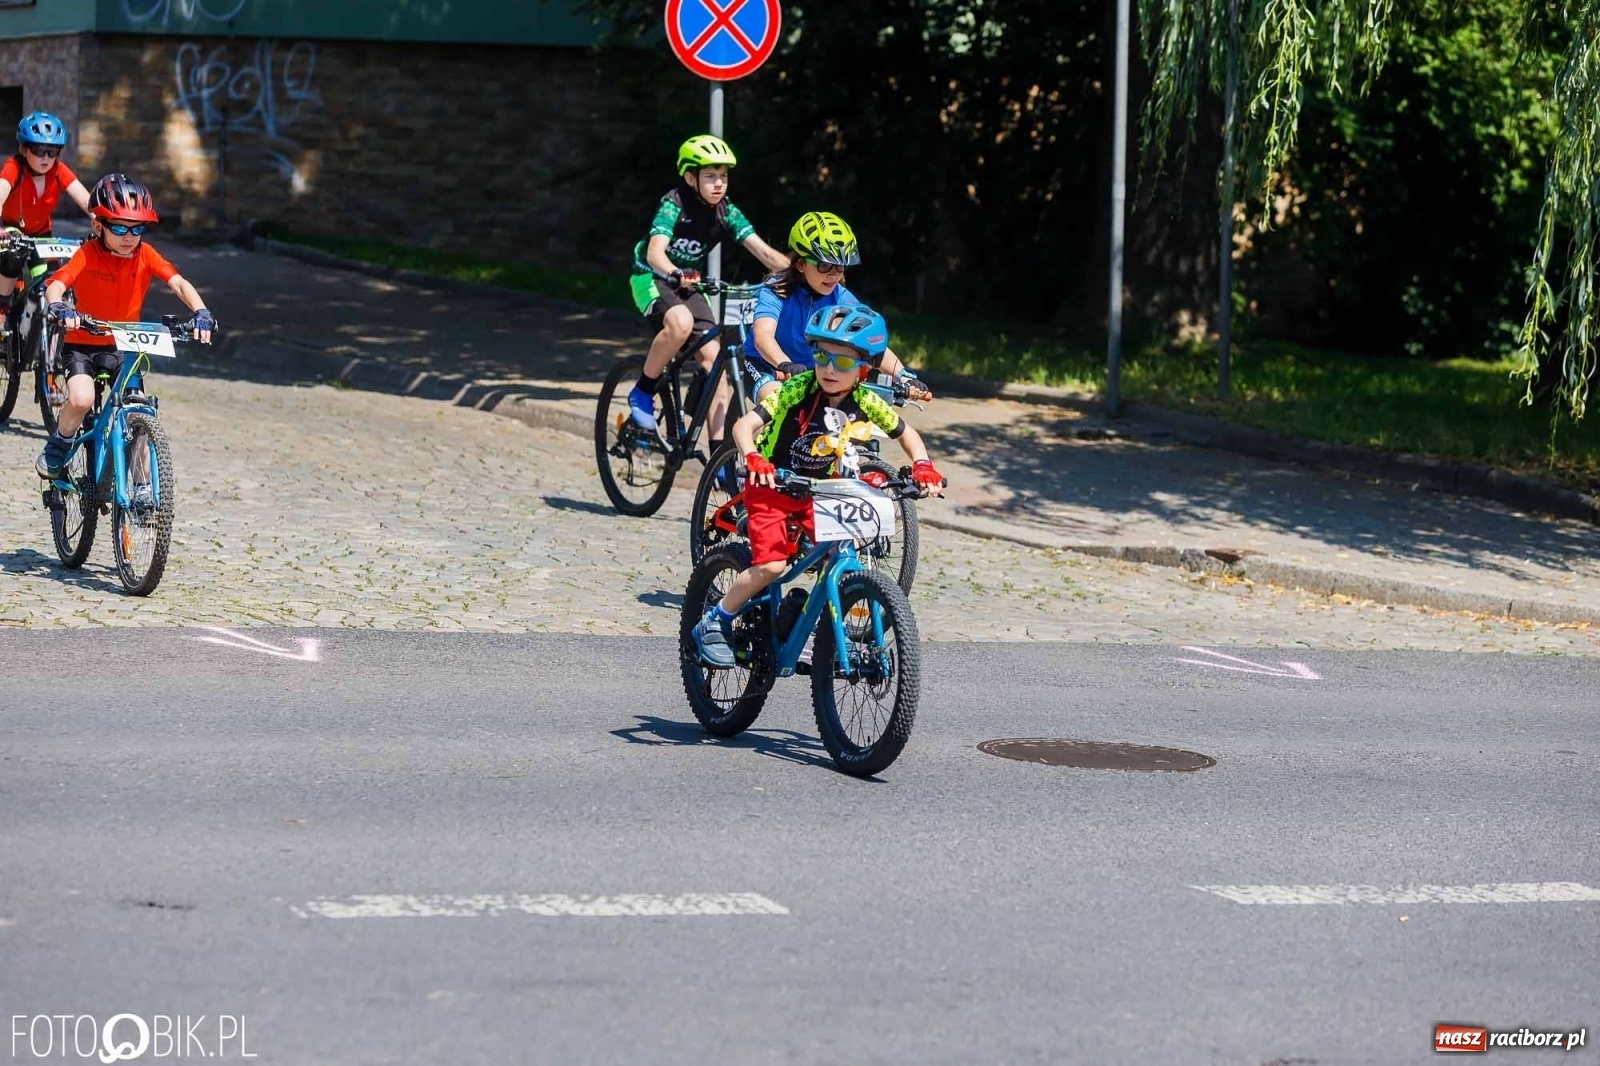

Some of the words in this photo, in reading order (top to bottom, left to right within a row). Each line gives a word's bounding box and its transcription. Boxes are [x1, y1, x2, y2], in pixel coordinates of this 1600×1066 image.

[738, 300, 758, 315] 14
[126, 332, 160, 346] 207
[833, 501, 874, 524] 120
